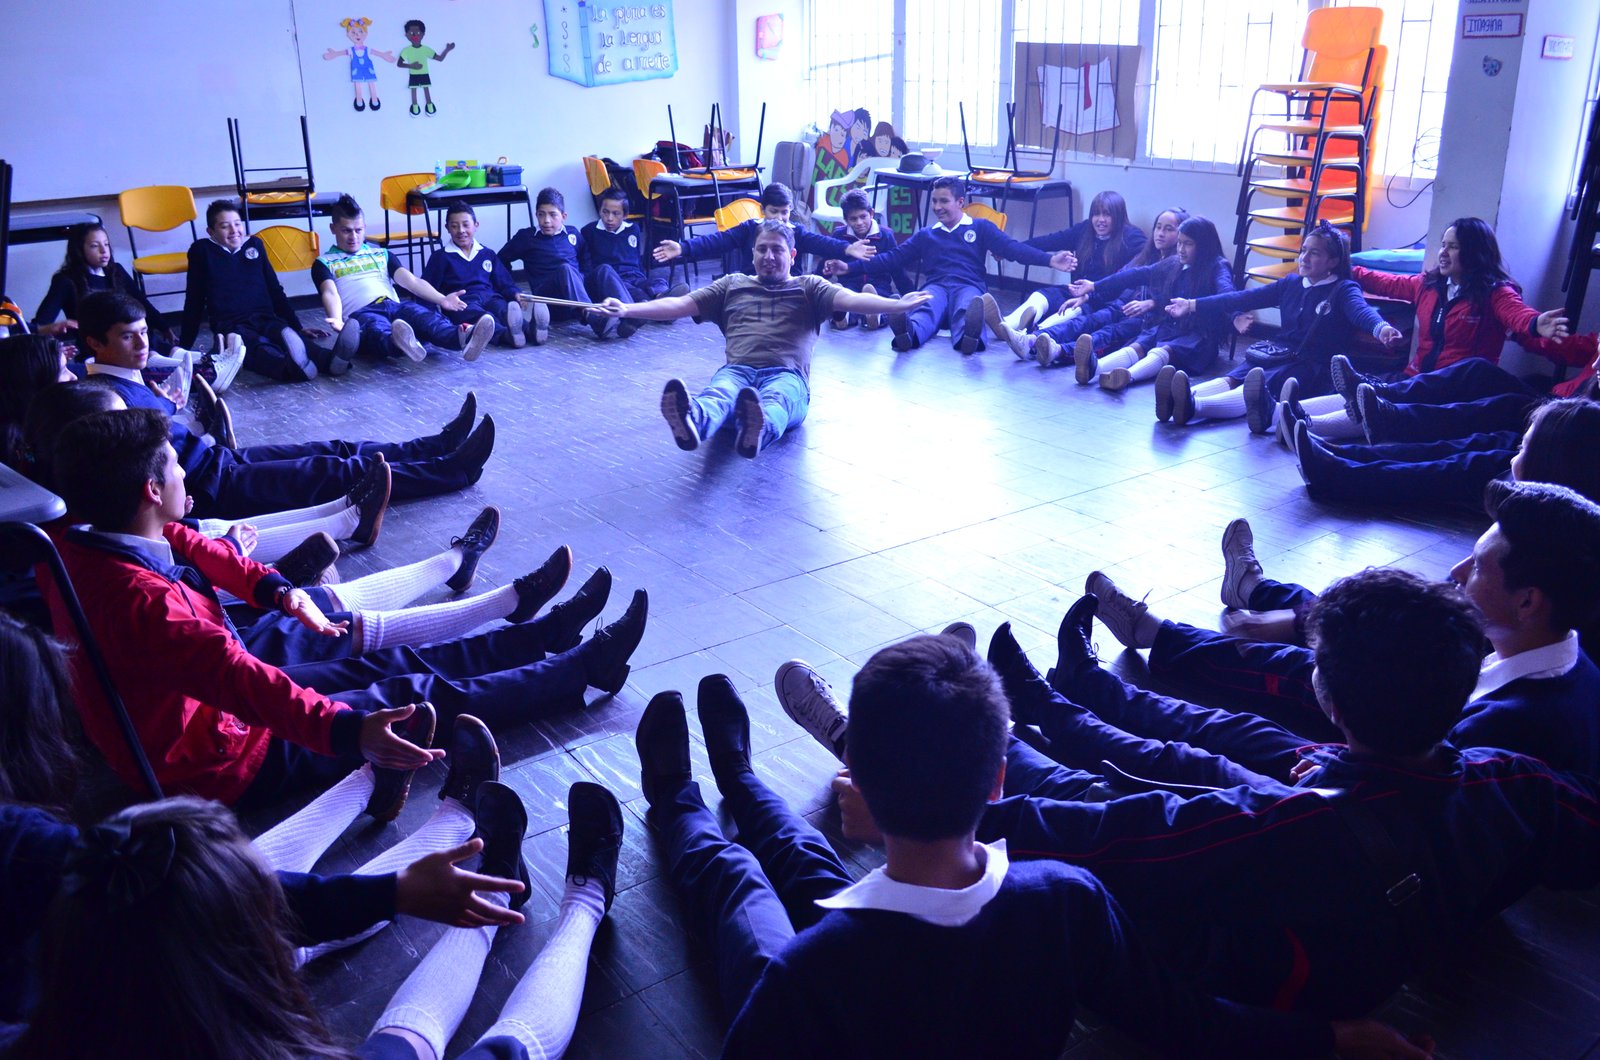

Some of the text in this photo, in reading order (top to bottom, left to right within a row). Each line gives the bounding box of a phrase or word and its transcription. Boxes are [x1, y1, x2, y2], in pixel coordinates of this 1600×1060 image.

[592, 4, 666, 29] La pluma es
[595, 54, 612, 75] de
[890, 186, 913, 206] ES
[891, 213, 913, 234] DE
